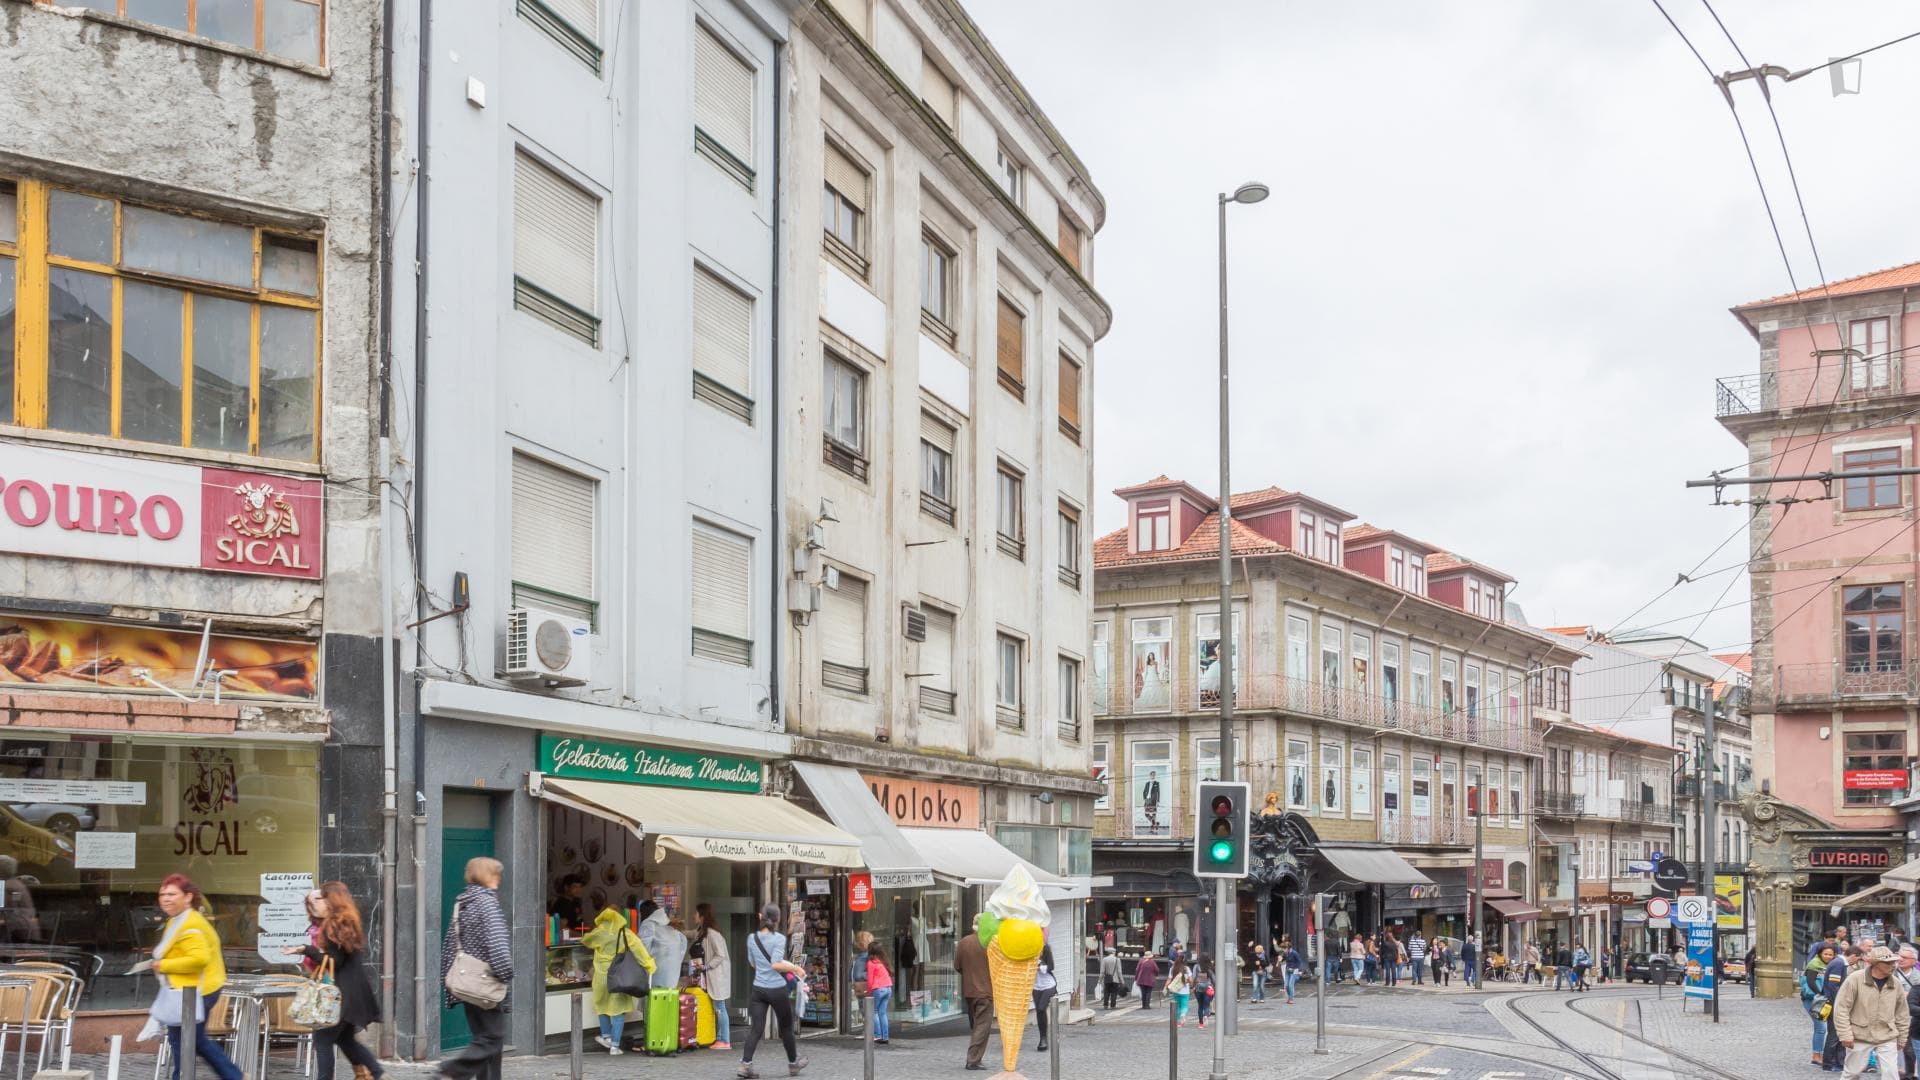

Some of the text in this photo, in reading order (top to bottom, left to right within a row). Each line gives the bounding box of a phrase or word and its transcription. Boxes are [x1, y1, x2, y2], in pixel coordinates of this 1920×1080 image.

[0, 476, 183, 540] OURO
[215, 537, 310, 569] SICAL
[552, 739, 760, 784] Gelateria Italiana Monalisa
[871, 782, 962, 823] Moloko
[174, 820, 248, 856] SICAL
[704, 838, 746, 855] Gelateria
[1810, 851, 1889, 866] LIVRARIA
[874, 874, 913, 886] TABACARIA
